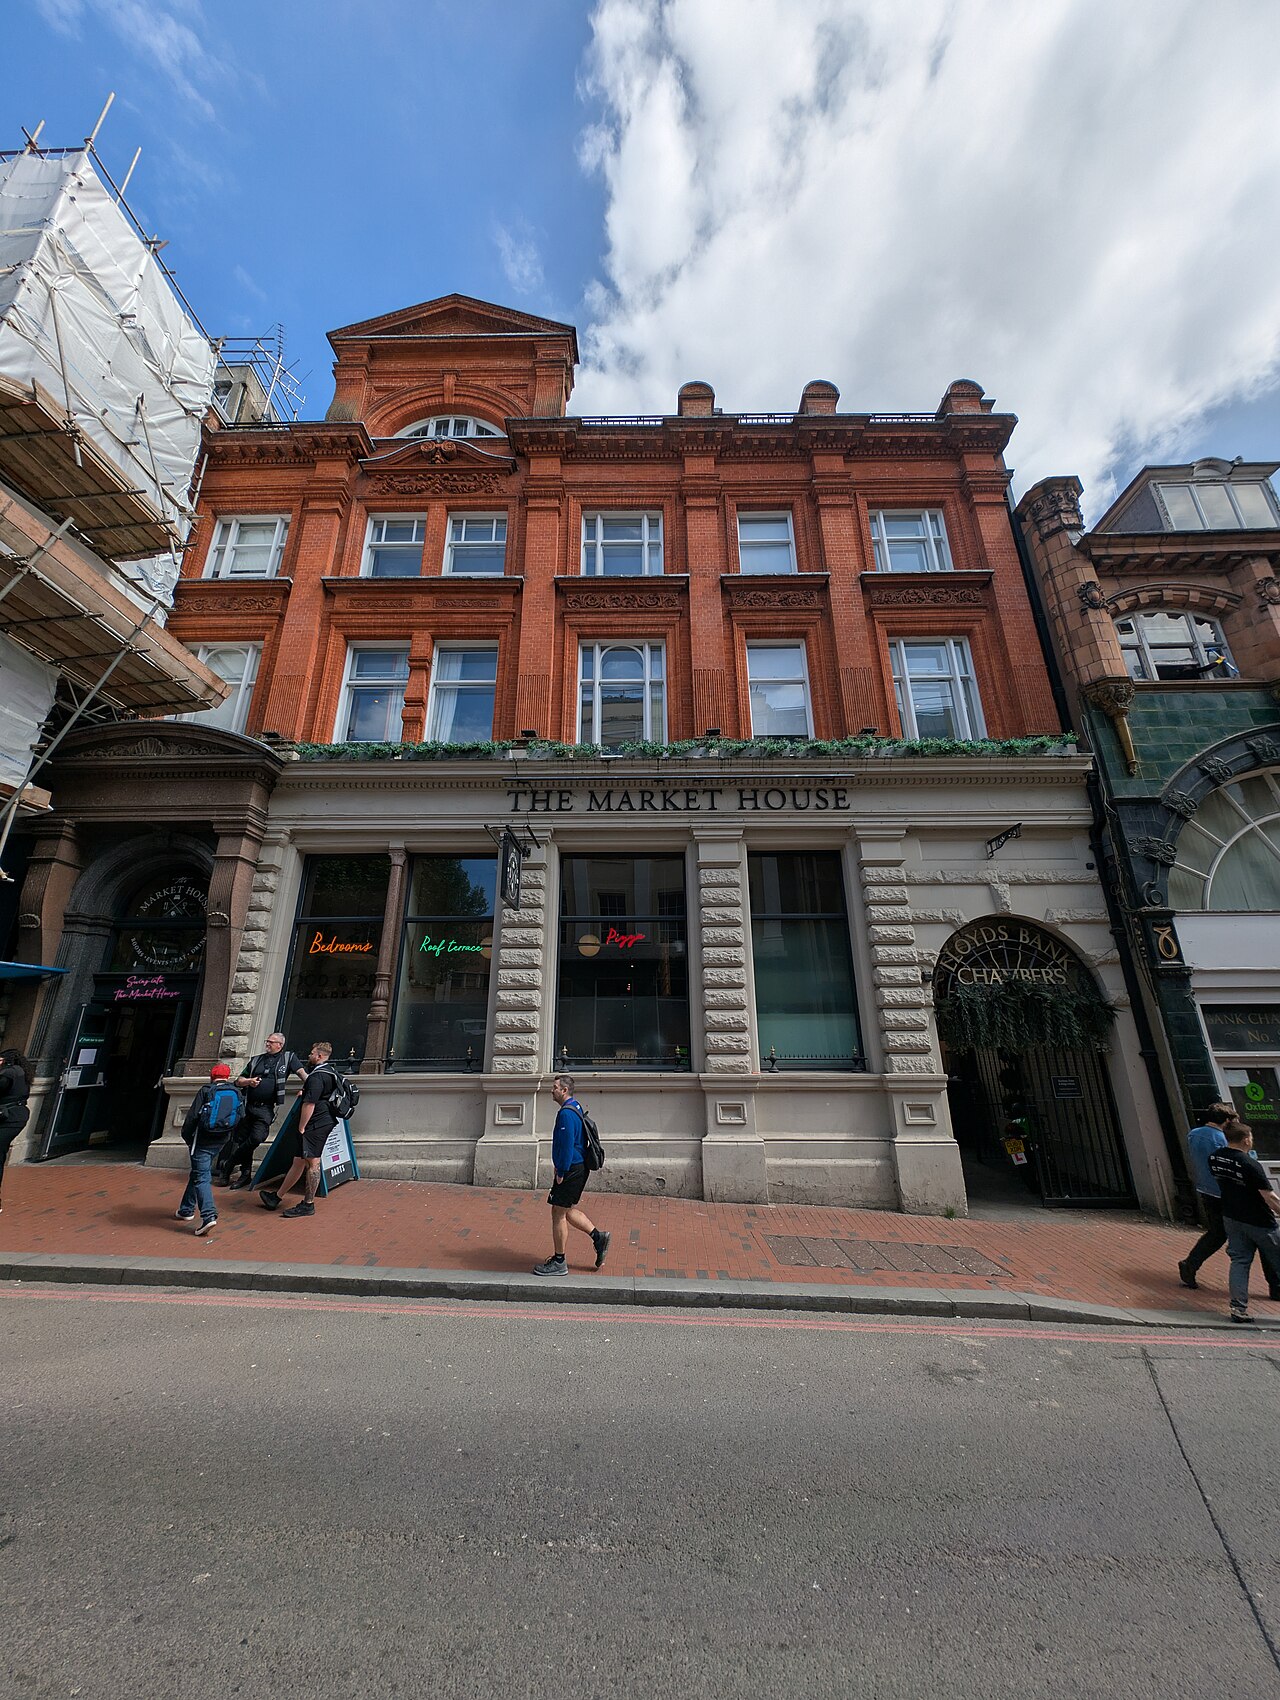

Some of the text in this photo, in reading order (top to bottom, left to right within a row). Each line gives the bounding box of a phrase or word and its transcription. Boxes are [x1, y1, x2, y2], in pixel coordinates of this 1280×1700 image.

[507, 788, 850, 812] THE MARKET HOUSE
[140, 885, 184, 912] MARKET
[309, 931, 373, 954] Bedrooms
[420, 935, 484, 957] Roof terrace
[606, 927, 646, 948] Pizza
[939, 925, 1075, 973] LLOYDS BANK
[957, 968, 1067, 985] CHAMBERS
[155, 988, 180, 998] House
[1205, 1013, 1245, 1025] BANK
[1245, 1103, 1275, 1111] Oxfam
[330, 1164, 346, 1178] DARTS
